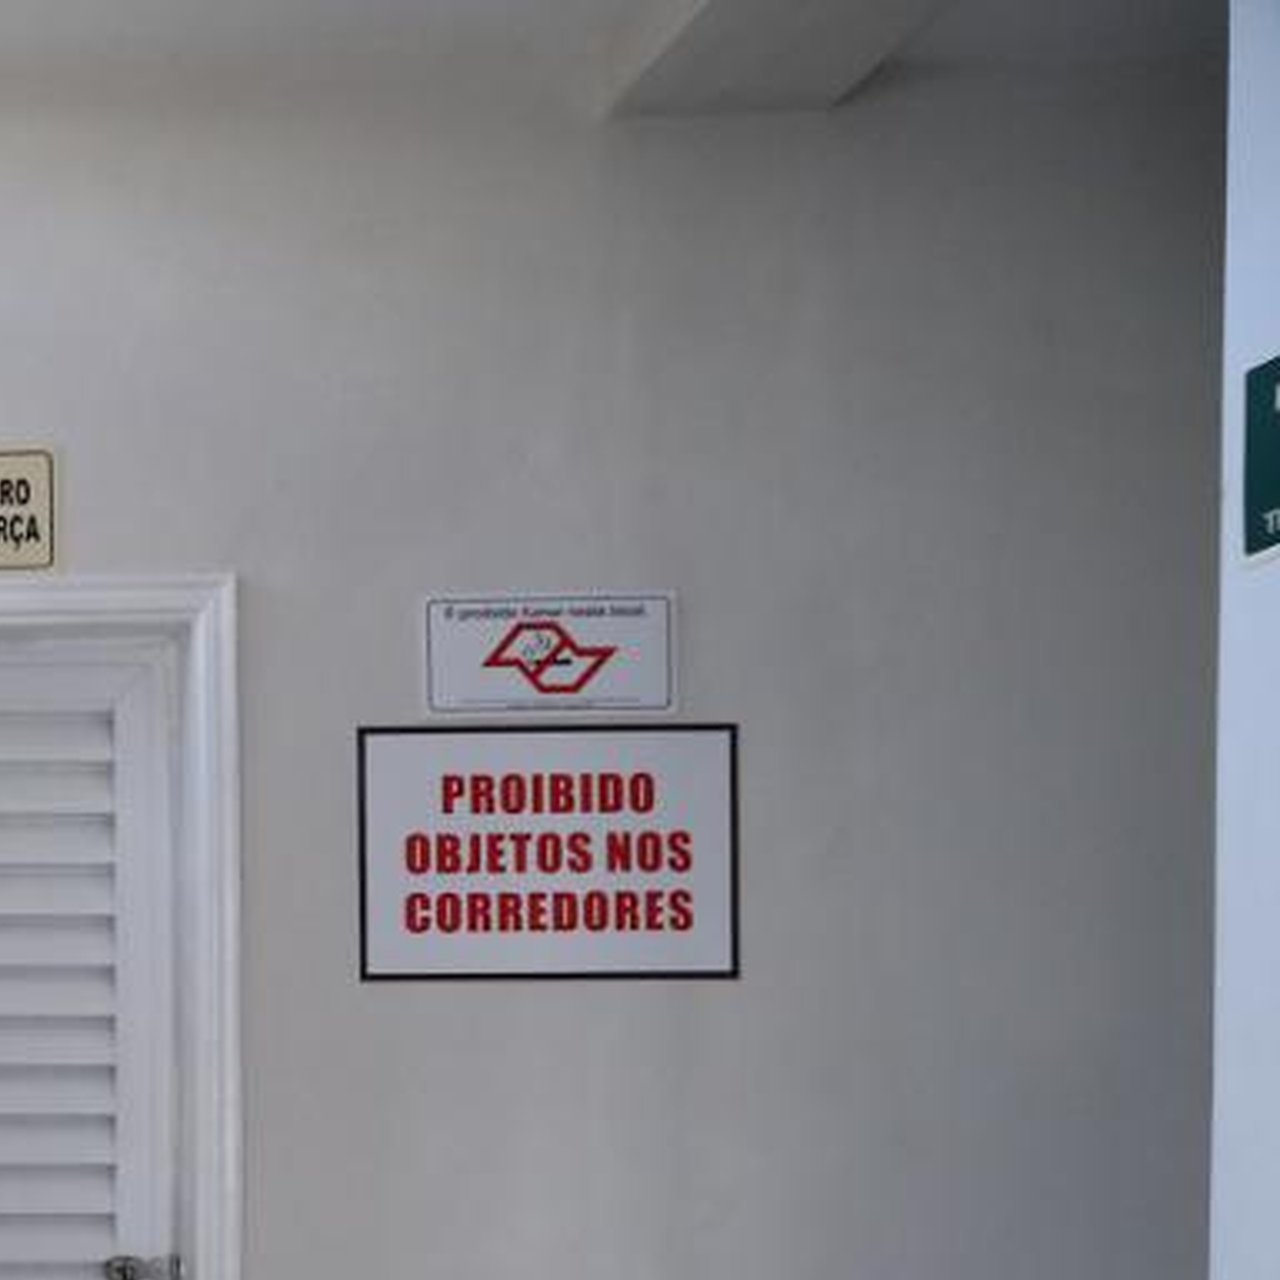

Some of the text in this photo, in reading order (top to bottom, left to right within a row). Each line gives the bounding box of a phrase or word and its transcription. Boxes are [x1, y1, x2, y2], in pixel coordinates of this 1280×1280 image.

[441, 772, 656, 814] PROIBIDO
[405, 831, 692, 873] OBJETOS NOS
[405, 890, 694, 932] CORREDORES
